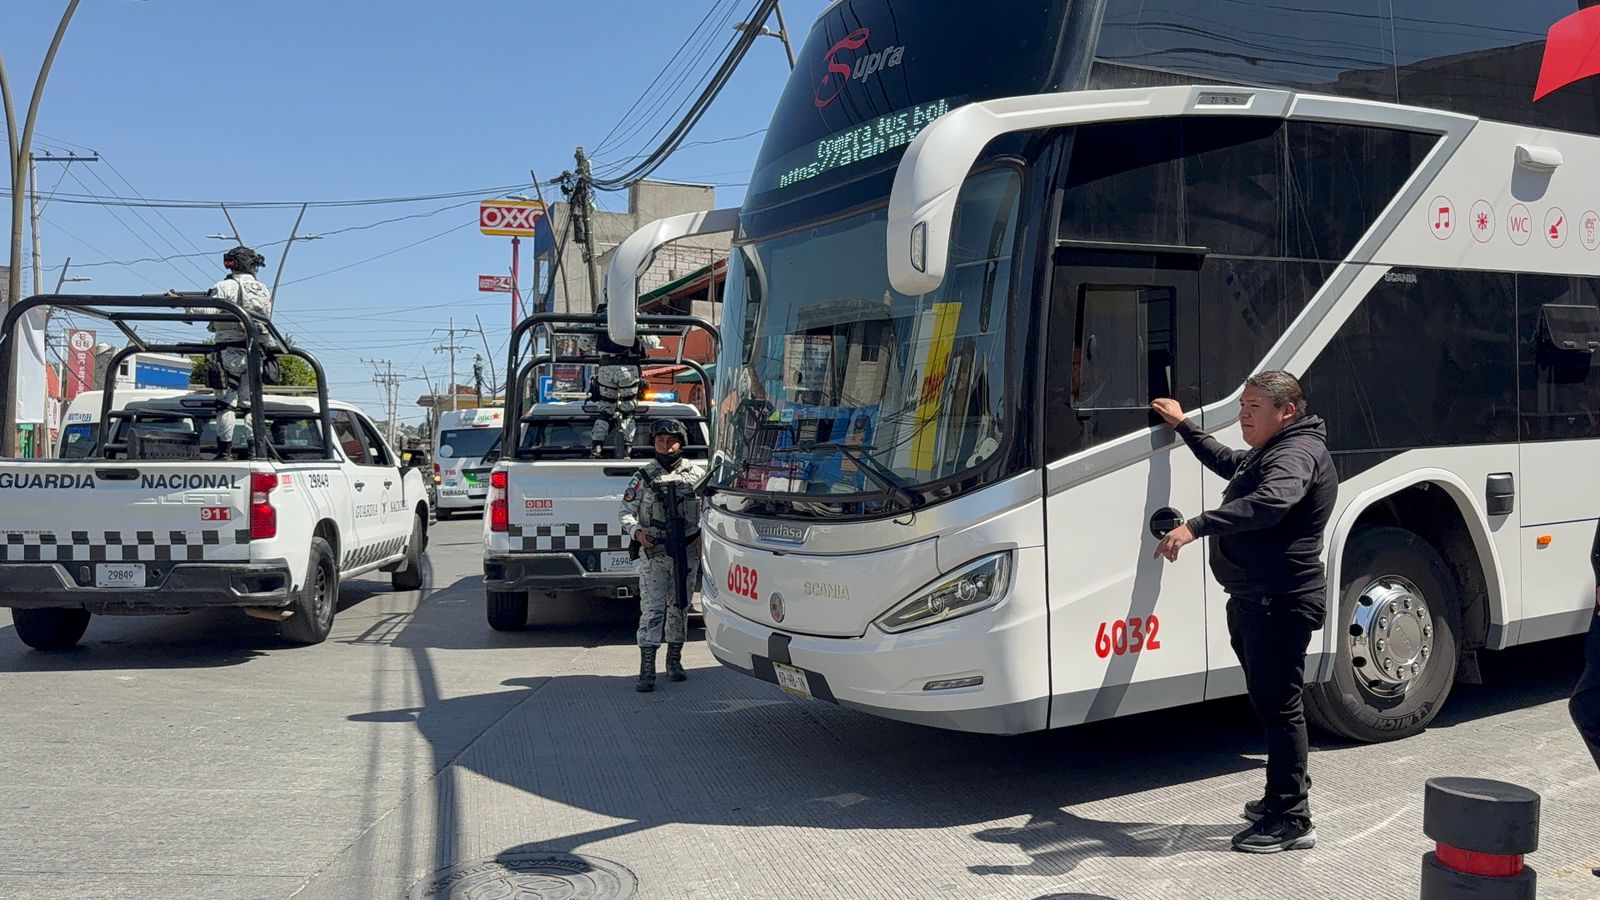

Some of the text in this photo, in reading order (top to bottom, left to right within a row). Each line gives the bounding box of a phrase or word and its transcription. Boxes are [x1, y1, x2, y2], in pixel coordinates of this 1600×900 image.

[814, 27, 905, 108] Supra
[817, 125, 872, 158] Compra
[877, 113, 908, 136] tus
[1510, 216, 1529, 233] WC
[1384, 272, 1417, 284] SCANIA
[0, 473, 242, 490] GUARDIA NACIONAL
[308, 474, 330, 489] 29849
[442, 489, 469, 497] PARADAS
[355, 503, 378, 519] GUARDIA
[527, 500, 552, 508] 088
[201, 508, 231, 519] 911
[107, 570, 134, 581] 29849
[727, 562, 759, 601] 6032
[803, 580, 850, 601] SCANIA
[1095, 614, 1161, 659] 6032
